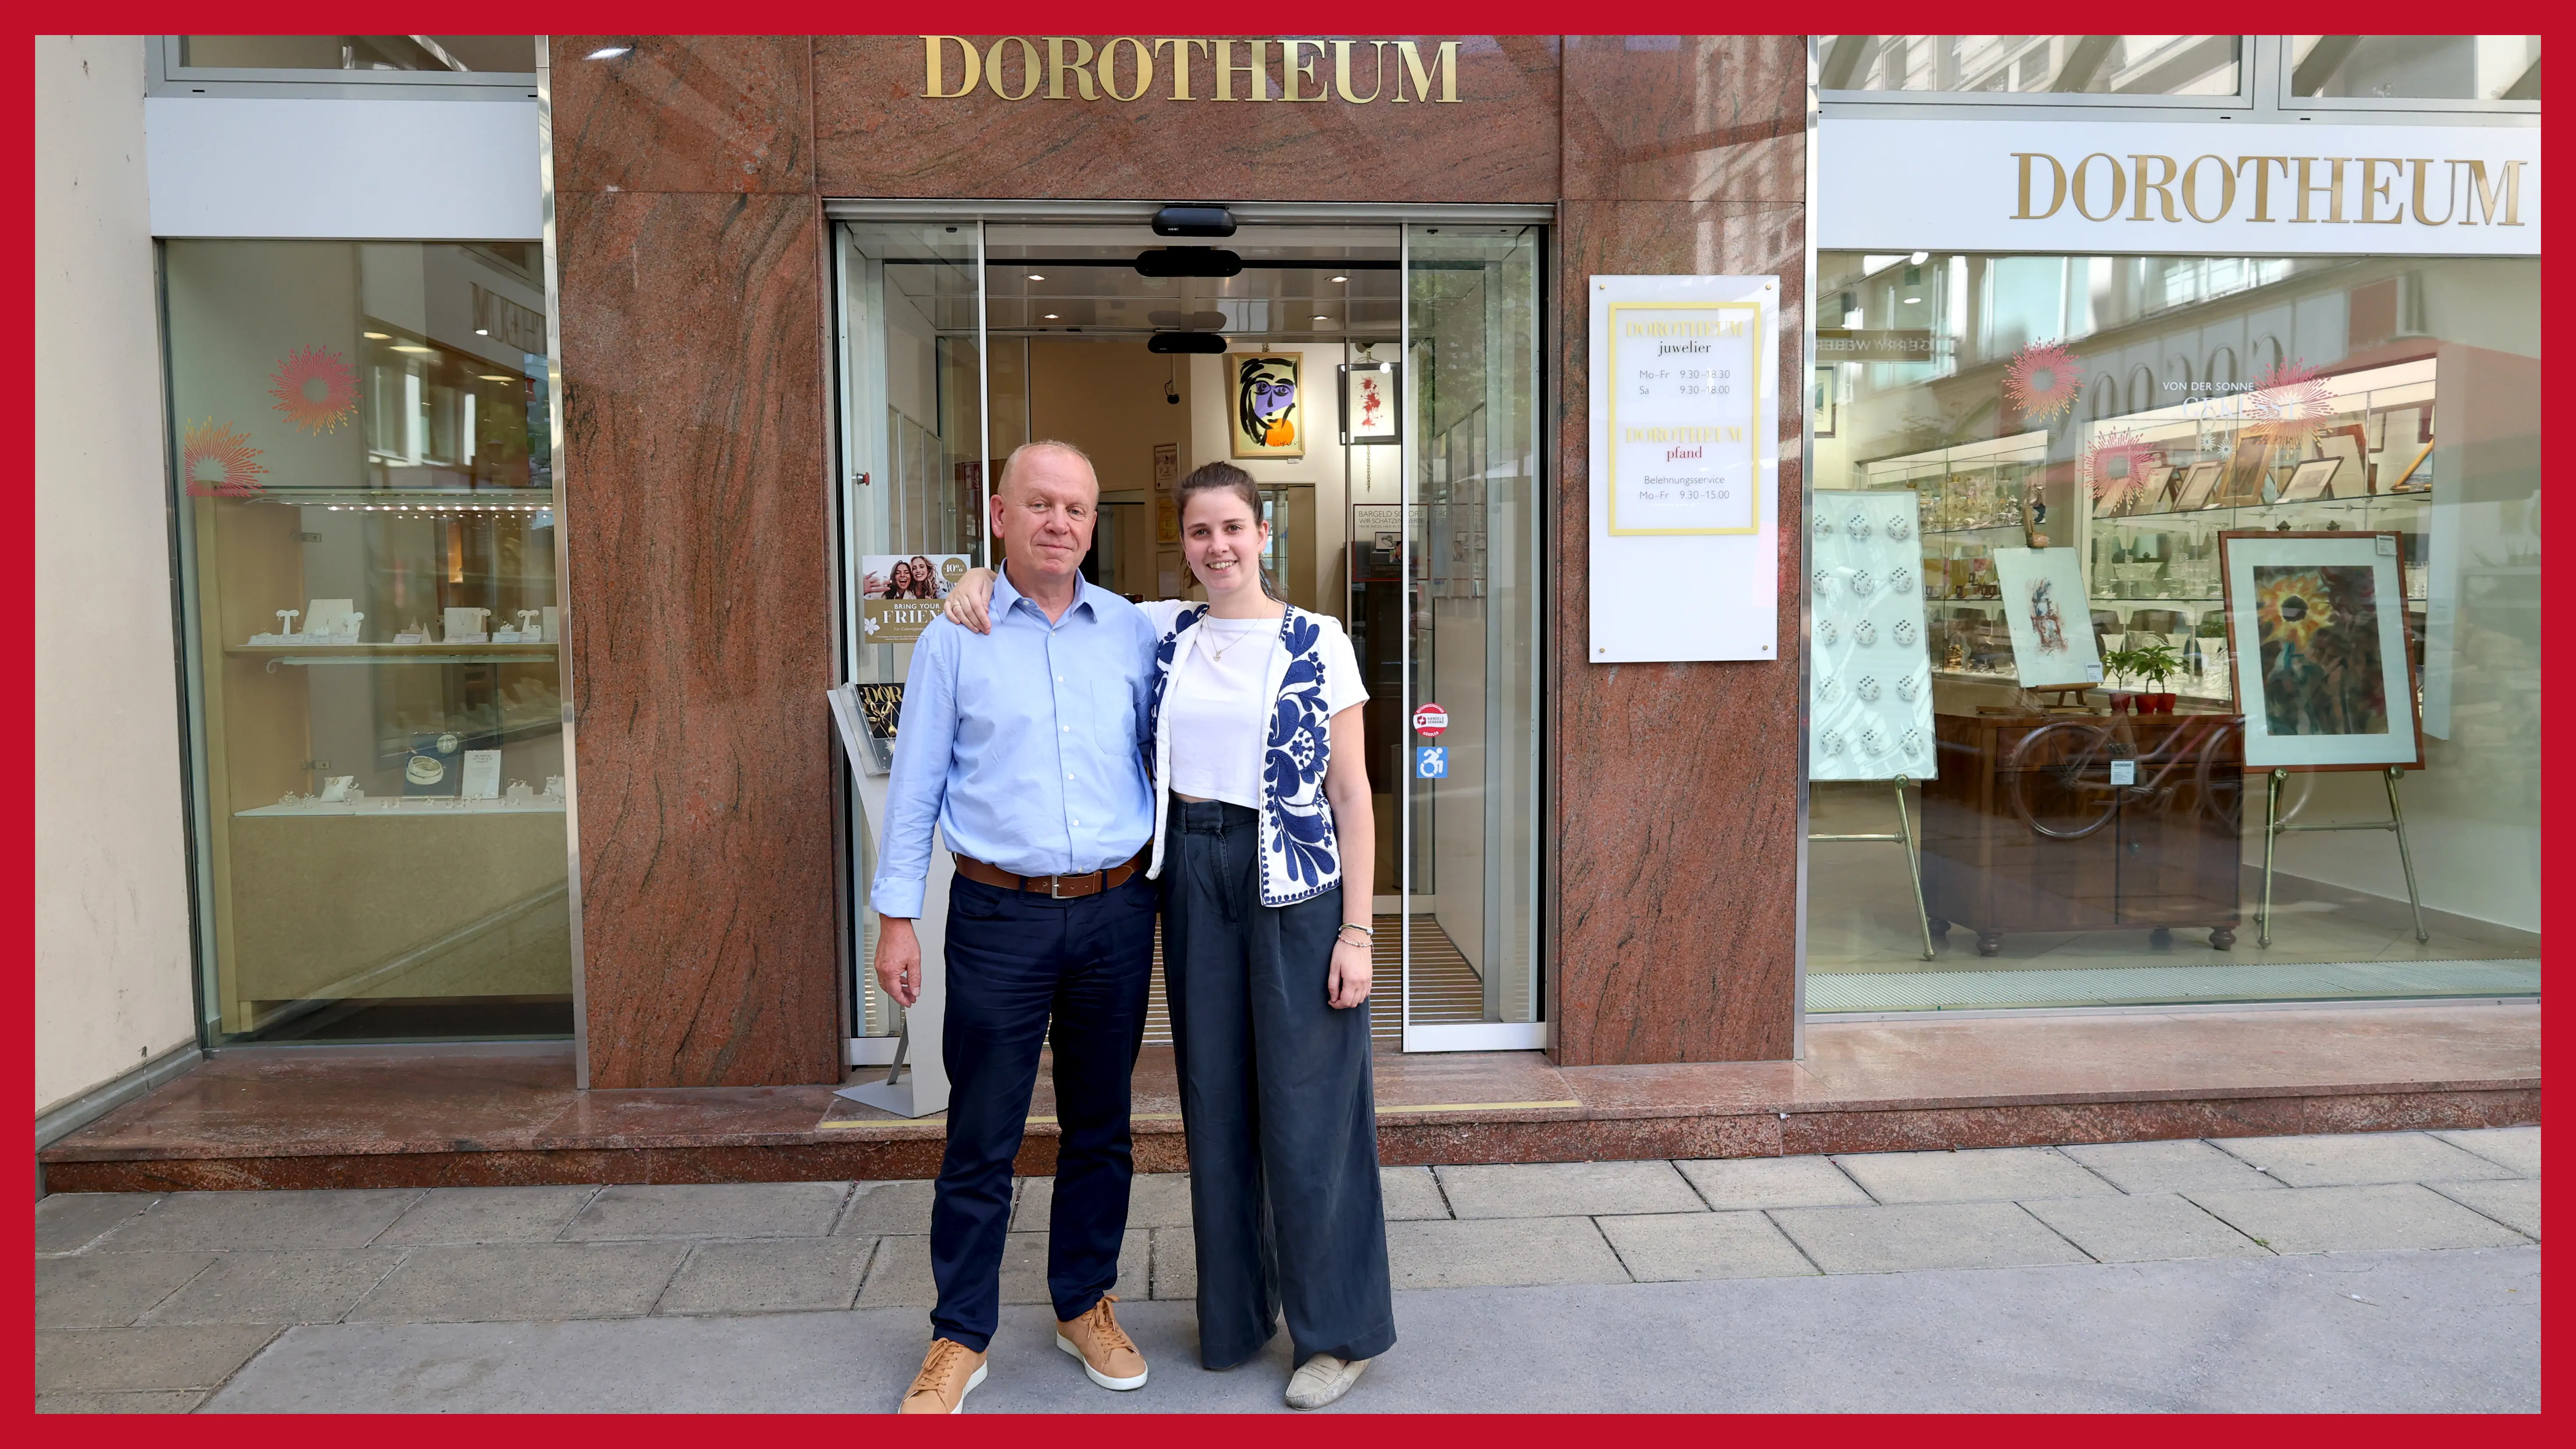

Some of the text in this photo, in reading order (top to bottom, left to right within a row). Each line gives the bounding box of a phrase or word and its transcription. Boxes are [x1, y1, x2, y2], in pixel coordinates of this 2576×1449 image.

[919, 35, 1463, 103] DOROTHEUM
[2009, 152, 2529, 226] DOROTHEUM
[1626, 320, 1743, 337] DOROTHEUM
[1658, 340, 1711, 357] juwelier
[1640, 386, 1650, 395] Sa
[2163, 382, 2254, 391] VON DER SONNE
[1626, 426, 1743, 443] DOROTHEUM
[1667, 445, 1702, 462] pfand
[1644, 475, 1725, 486] Belehnungsservice
[883, 610, 945, 623] FRIEN
